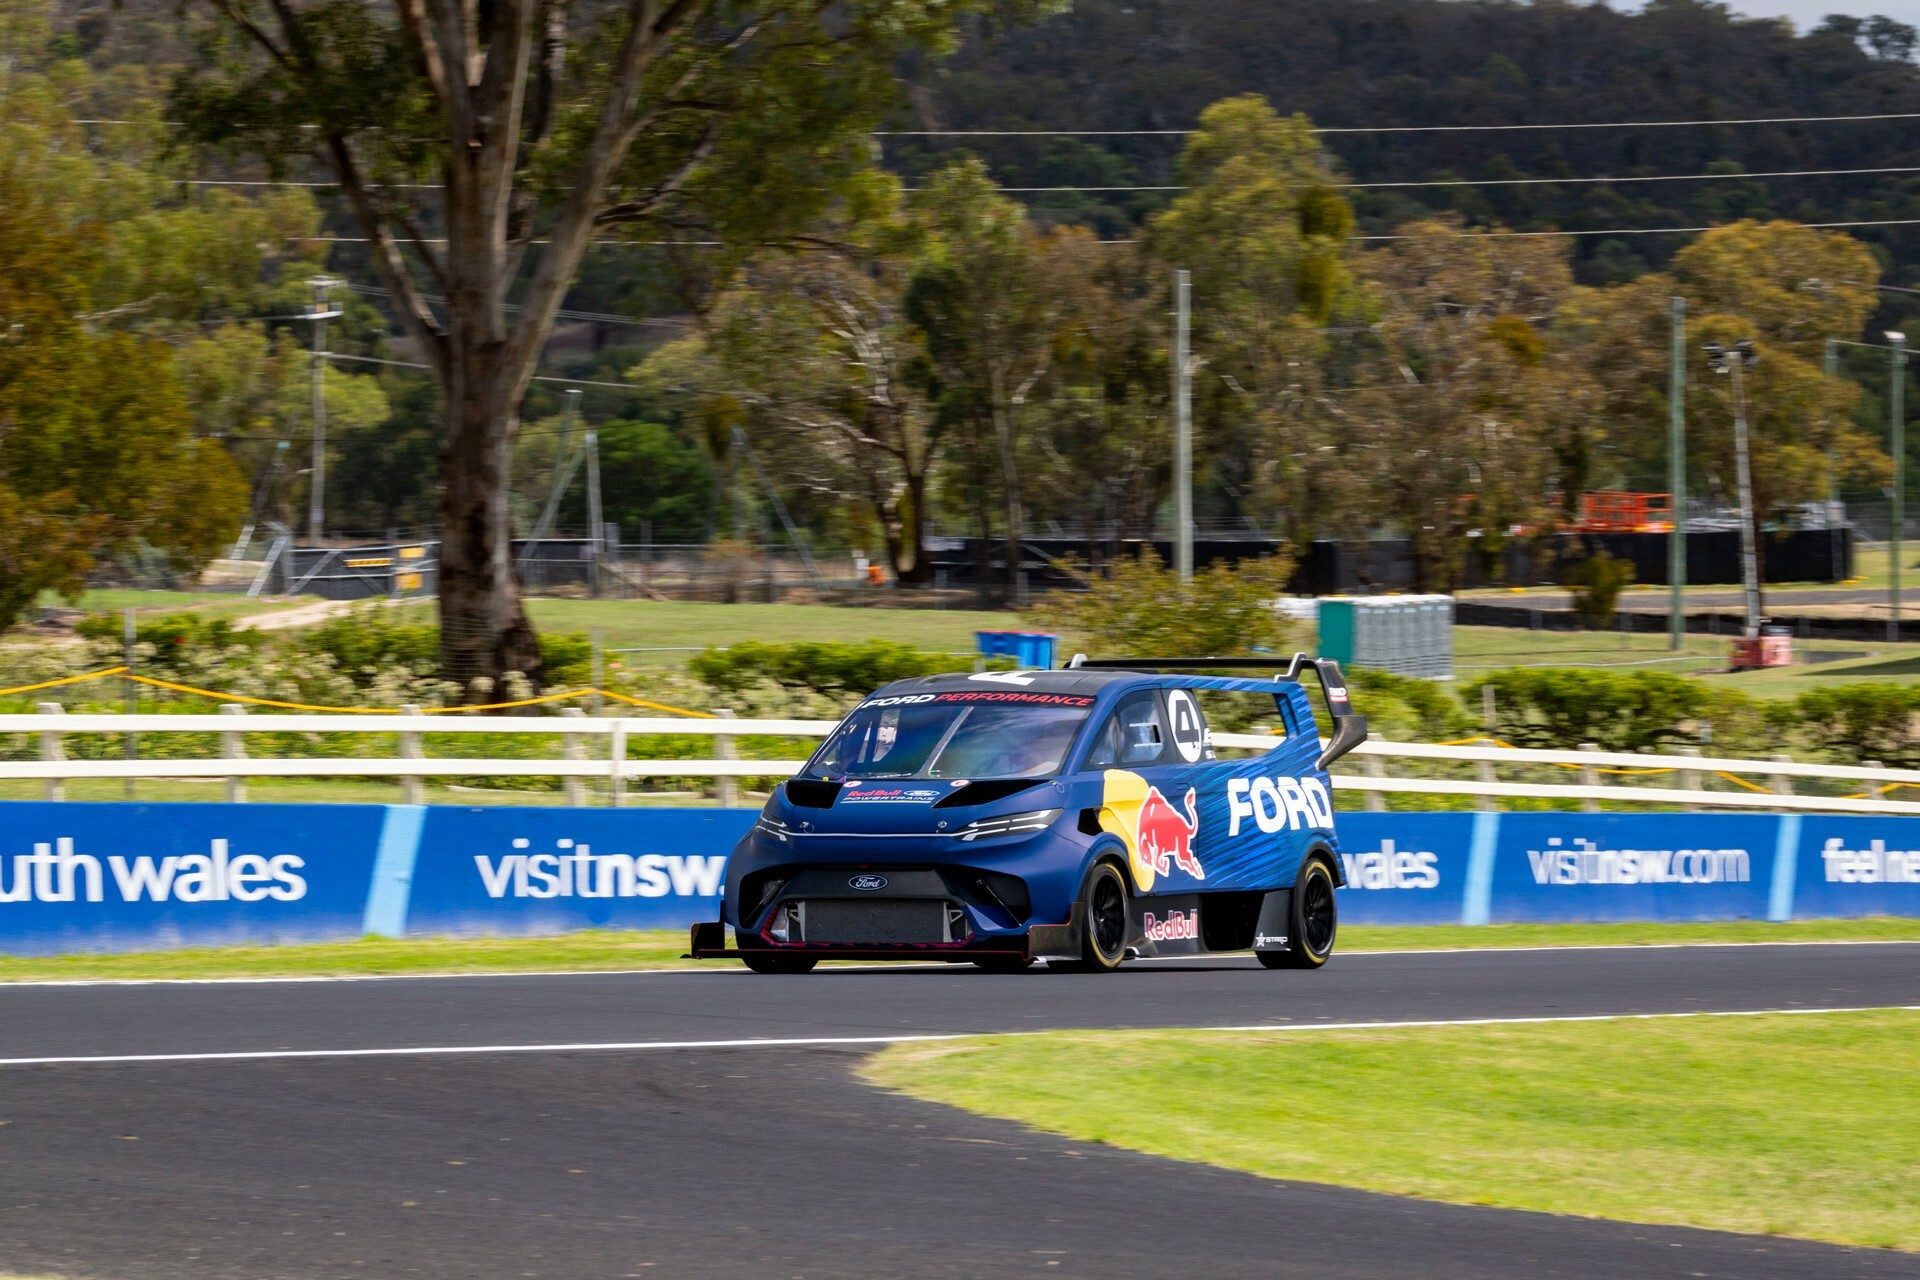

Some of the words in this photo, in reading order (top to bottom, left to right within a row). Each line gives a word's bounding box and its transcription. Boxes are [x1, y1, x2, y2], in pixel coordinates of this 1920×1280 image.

[861, 695, 935, 709] FORD
[933, 693, 1094, 707] PERFORMANCE
[1175, 699, 1200, 743] 4
[874, 789, 902, 797] Bull
[1227, 776, 1334, 837] FORD
[107, 838, 308, 902] wales
[855, 876, 881, 888] Ford
[1144, 910, 1174, 941] Red
[1174, 909, 1199, 939] Bull
